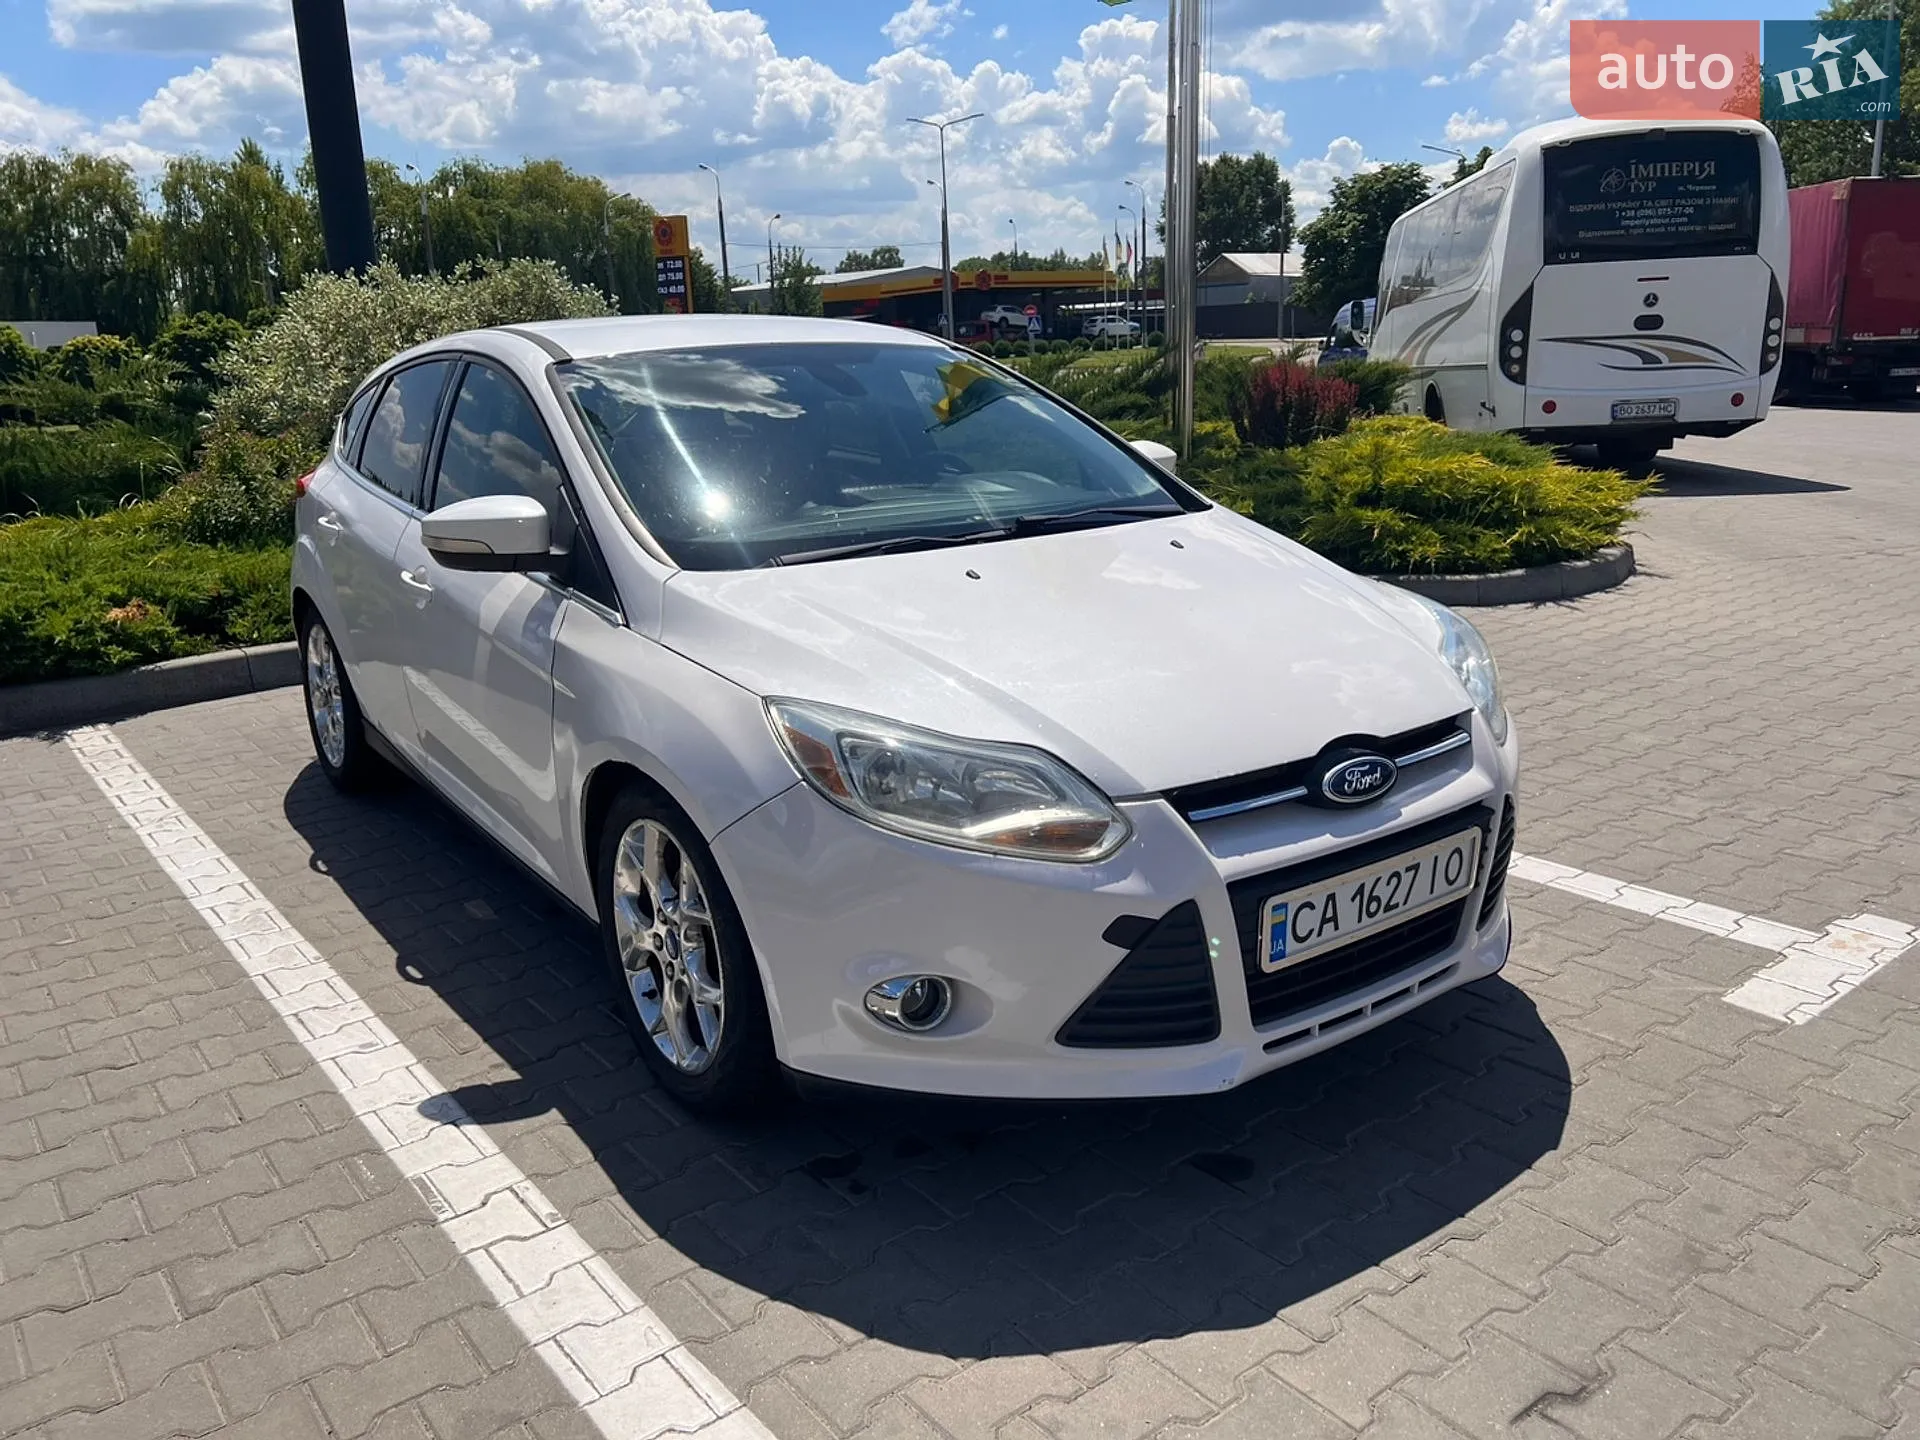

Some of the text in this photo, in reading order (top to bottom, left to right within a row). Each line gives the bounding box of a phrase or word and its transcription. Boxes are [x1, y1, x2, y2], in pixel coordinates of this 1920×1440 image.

[1642, 199, 1653, 207] ТА
[1675, 197, 1704, 206] РАЗОМ
[1344, 764, 1382, 794] Ford
[1291, 847, 1463, 944] CA 1627 IO
